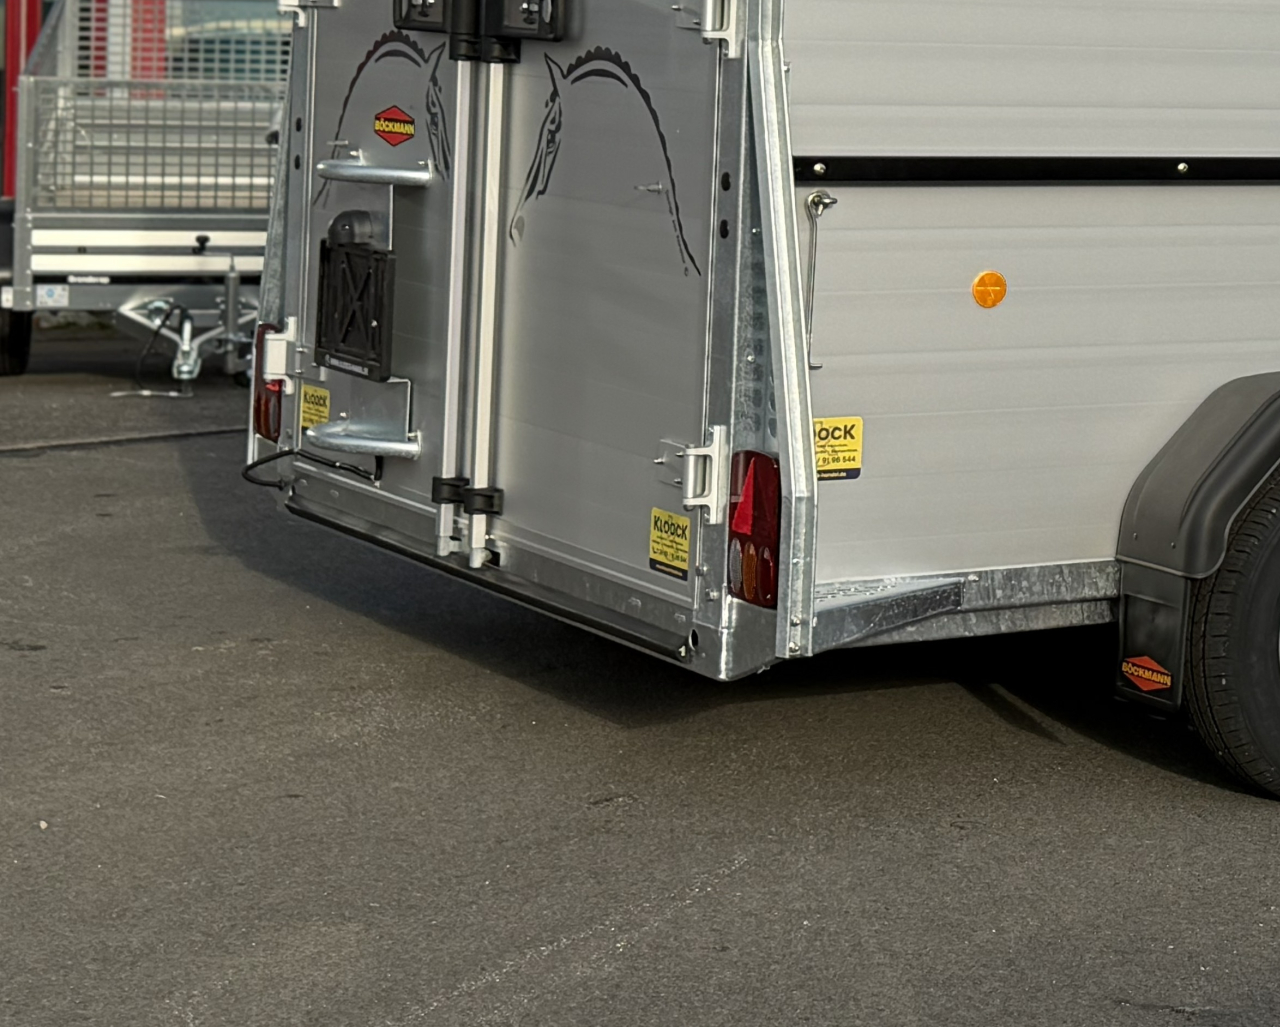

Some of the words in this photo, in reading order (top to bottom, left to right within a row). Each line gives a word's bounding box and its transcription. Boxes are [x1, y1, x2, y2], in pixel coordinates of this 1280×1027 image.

[814, 423, 856, 441] OCK
[842, 455, 856, 463] 544
[653, 515, 688, 541] KLOOCK
